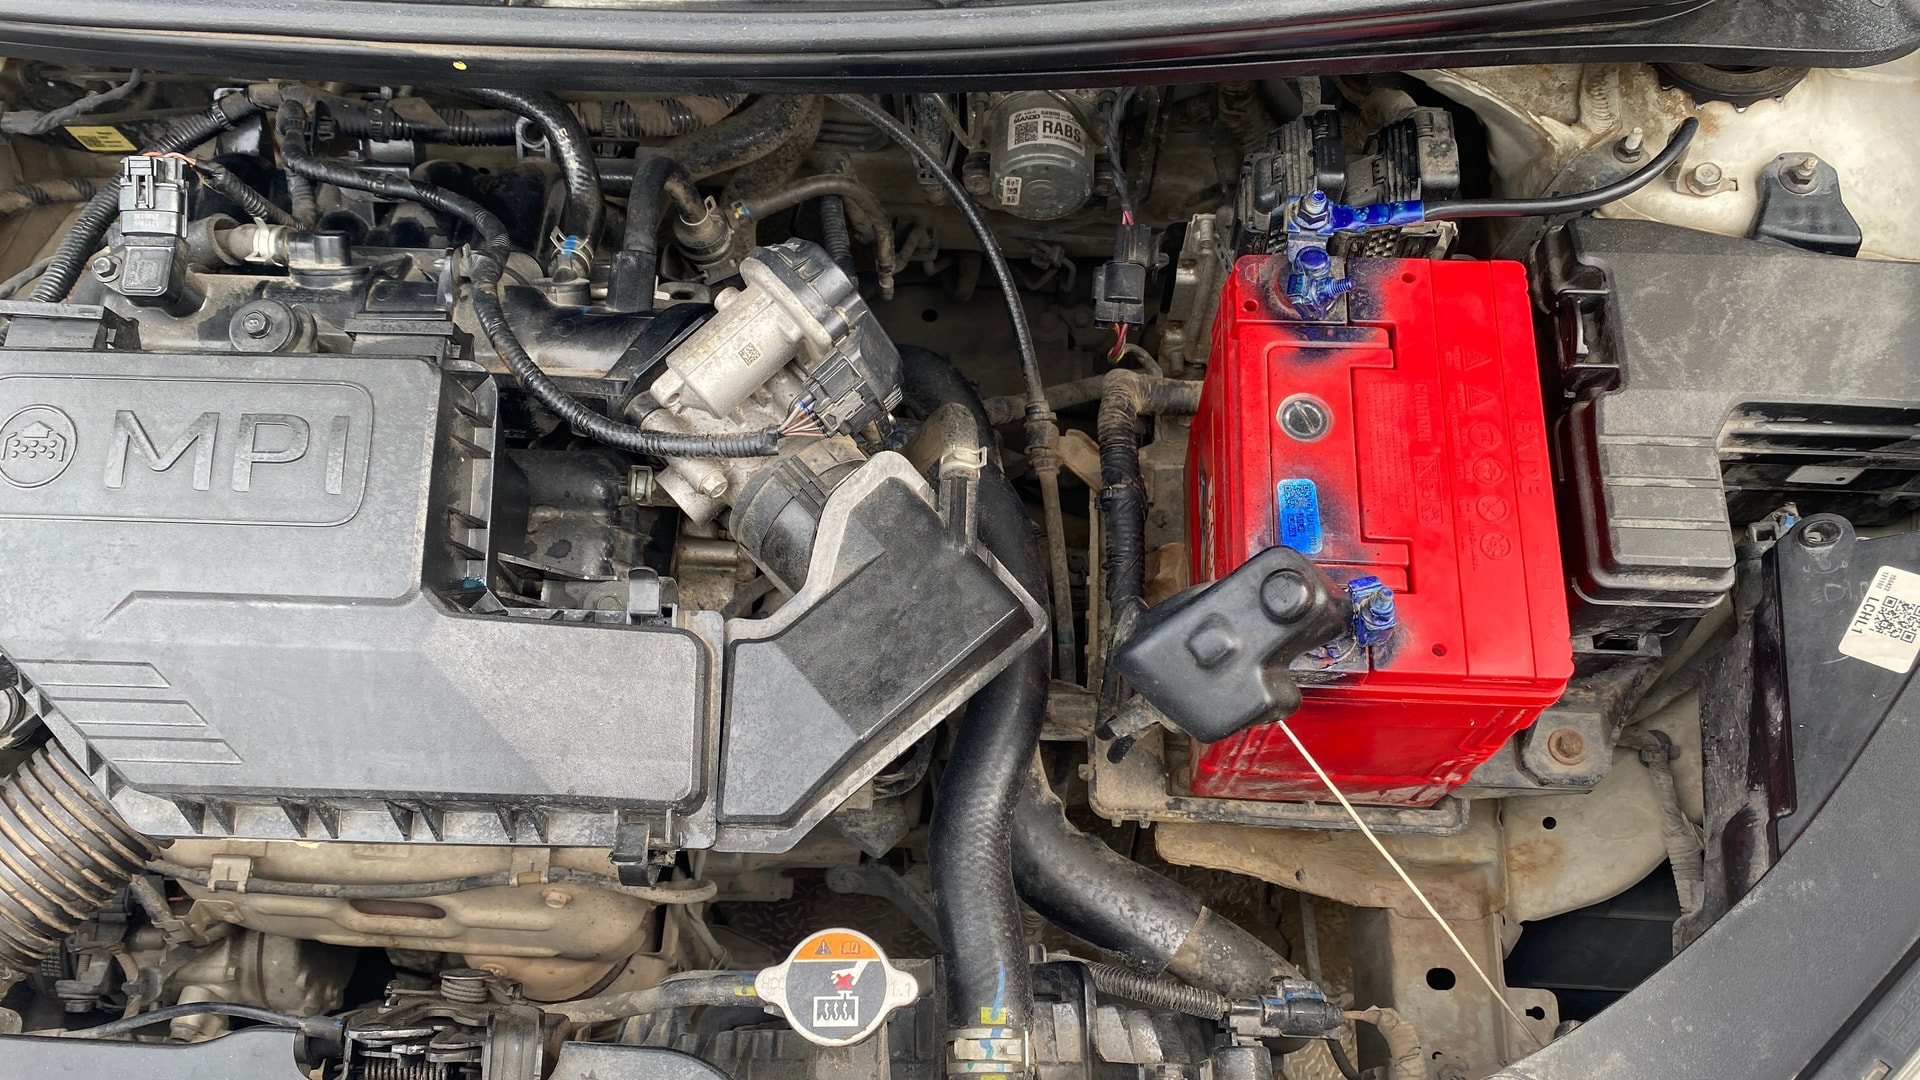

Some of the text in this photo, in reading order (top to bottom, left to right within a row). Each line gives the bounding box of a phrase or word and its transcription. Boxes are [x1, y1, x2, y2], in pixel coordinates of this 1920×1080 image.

[1042, 120, 1081, 142] RABS
[104, 410, 349, 495] MPI
[1513, 418, 1545, 497] EXIDE
[1851, 596, 1880, 634] LCHL1
